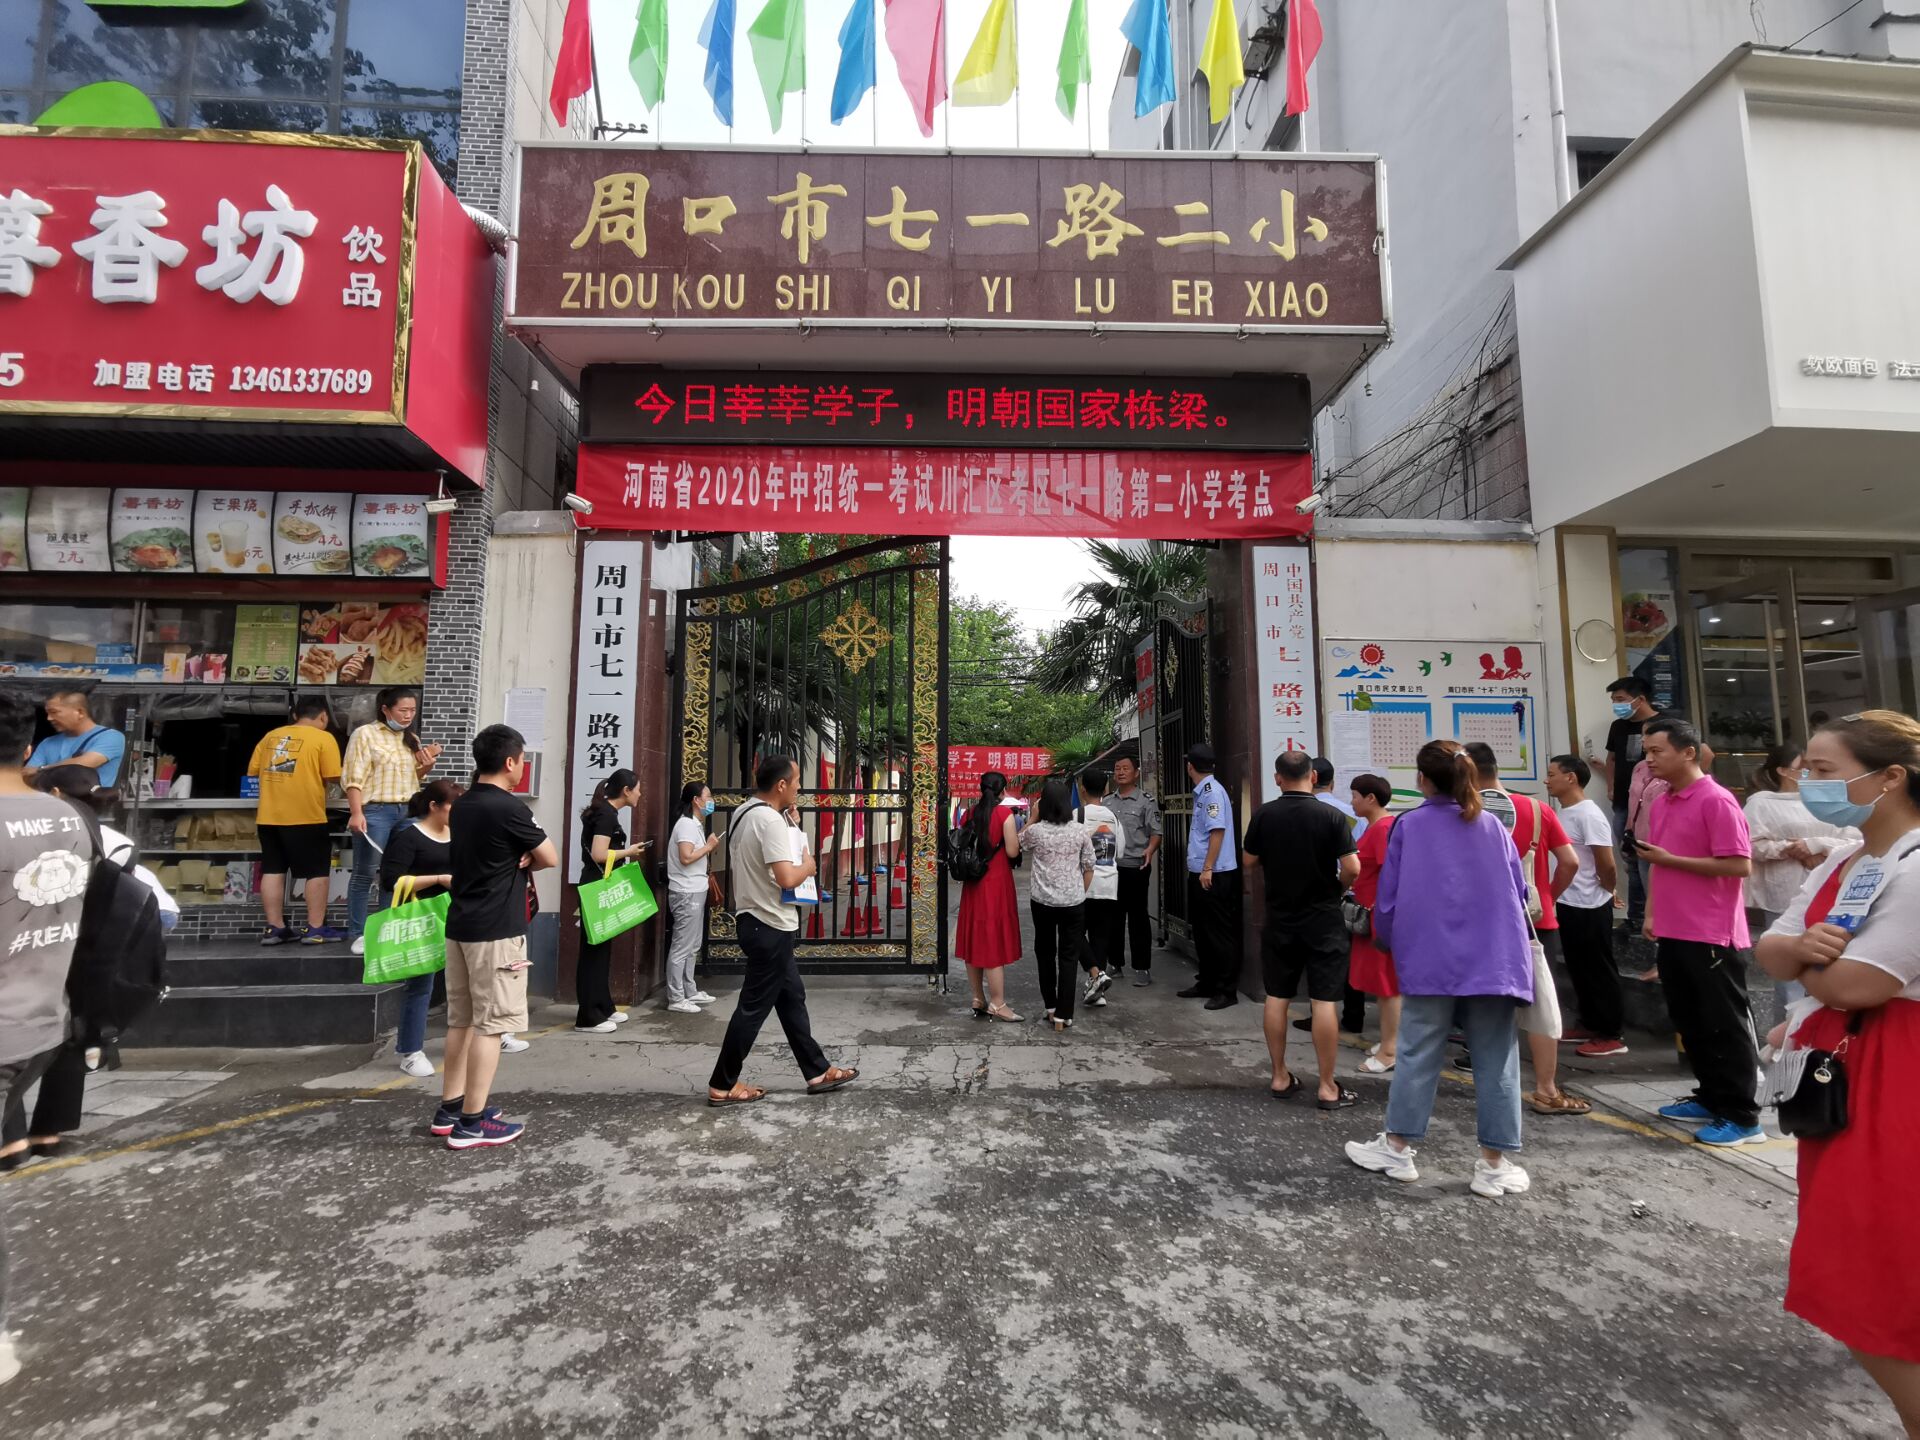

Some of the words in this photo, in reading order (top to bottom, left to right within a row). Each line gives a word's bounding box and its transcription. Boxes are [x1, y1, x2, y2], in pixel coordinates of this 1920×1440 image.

[570, 171, 1329, 264] 周口市七一路二小
[342, 225, 387, 309] 饮品
[560, 272, 658, 310] ZHOU
[672, 273, 745, 311] KOU
[775, 275, 830, 311] SHI
[886, 276, 921, 312] QI
[981, 276, 1012, 313] YI
[1074, 277, 1116, 315] LU
[1171, 279, 1215, 317] ER
[1244, 280, 1329, 318] XIAO
[93, 358, 216, 392] 加盟电话
[229, 365, 373, 394] 13461337689
[1807, 354, 1880, 376] 软欧面包
[212, 498, 258, 513] 芒果烧
[289, 499, 338, 521] 手抓饼
[5, 818, 55, 839] MAKE
[59, 816, 82, 833] IT
